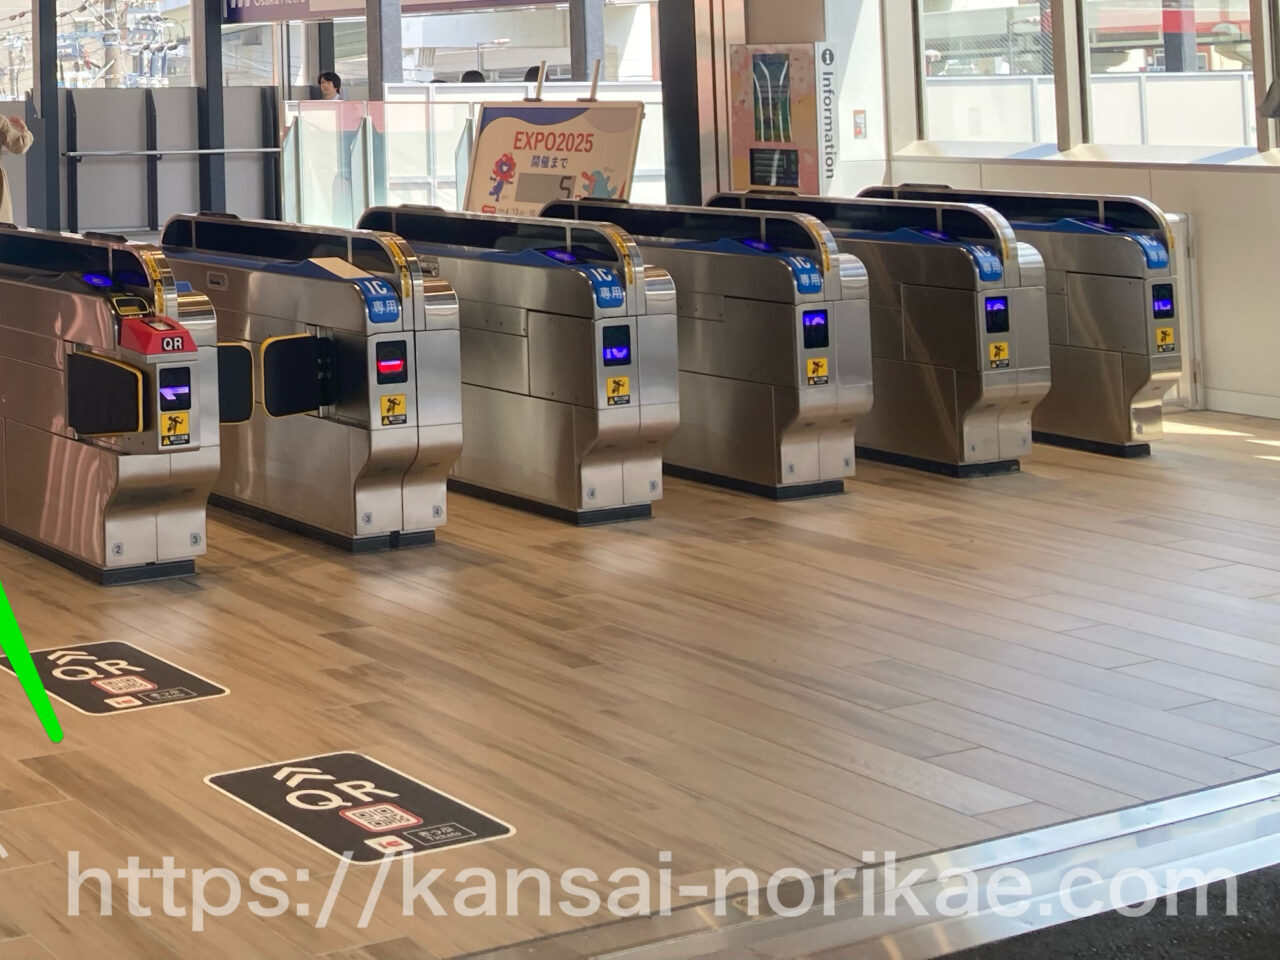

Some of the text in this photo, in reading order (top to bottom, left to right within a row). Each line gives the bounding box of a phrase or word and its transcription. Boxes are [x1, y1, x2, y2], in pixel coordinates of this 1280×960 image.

[822, 71, 837, 180] Information
[513, 131, 595, 152] EXPO2025
[530, 155, 568, 169] 開催まで
[790, 256, 811, 269] IC
[590, 268, 612, 281] IC
[364, 280, 387, 295] IC
[372, 300, 398, 314] 専用
[163, 337, 183, 351] QR
[193, 535, 199, 544] 3
[115, 545, 121, 554] 2
[52, 659, 145, 681] QR
[285, 780, 400, 810] QR
